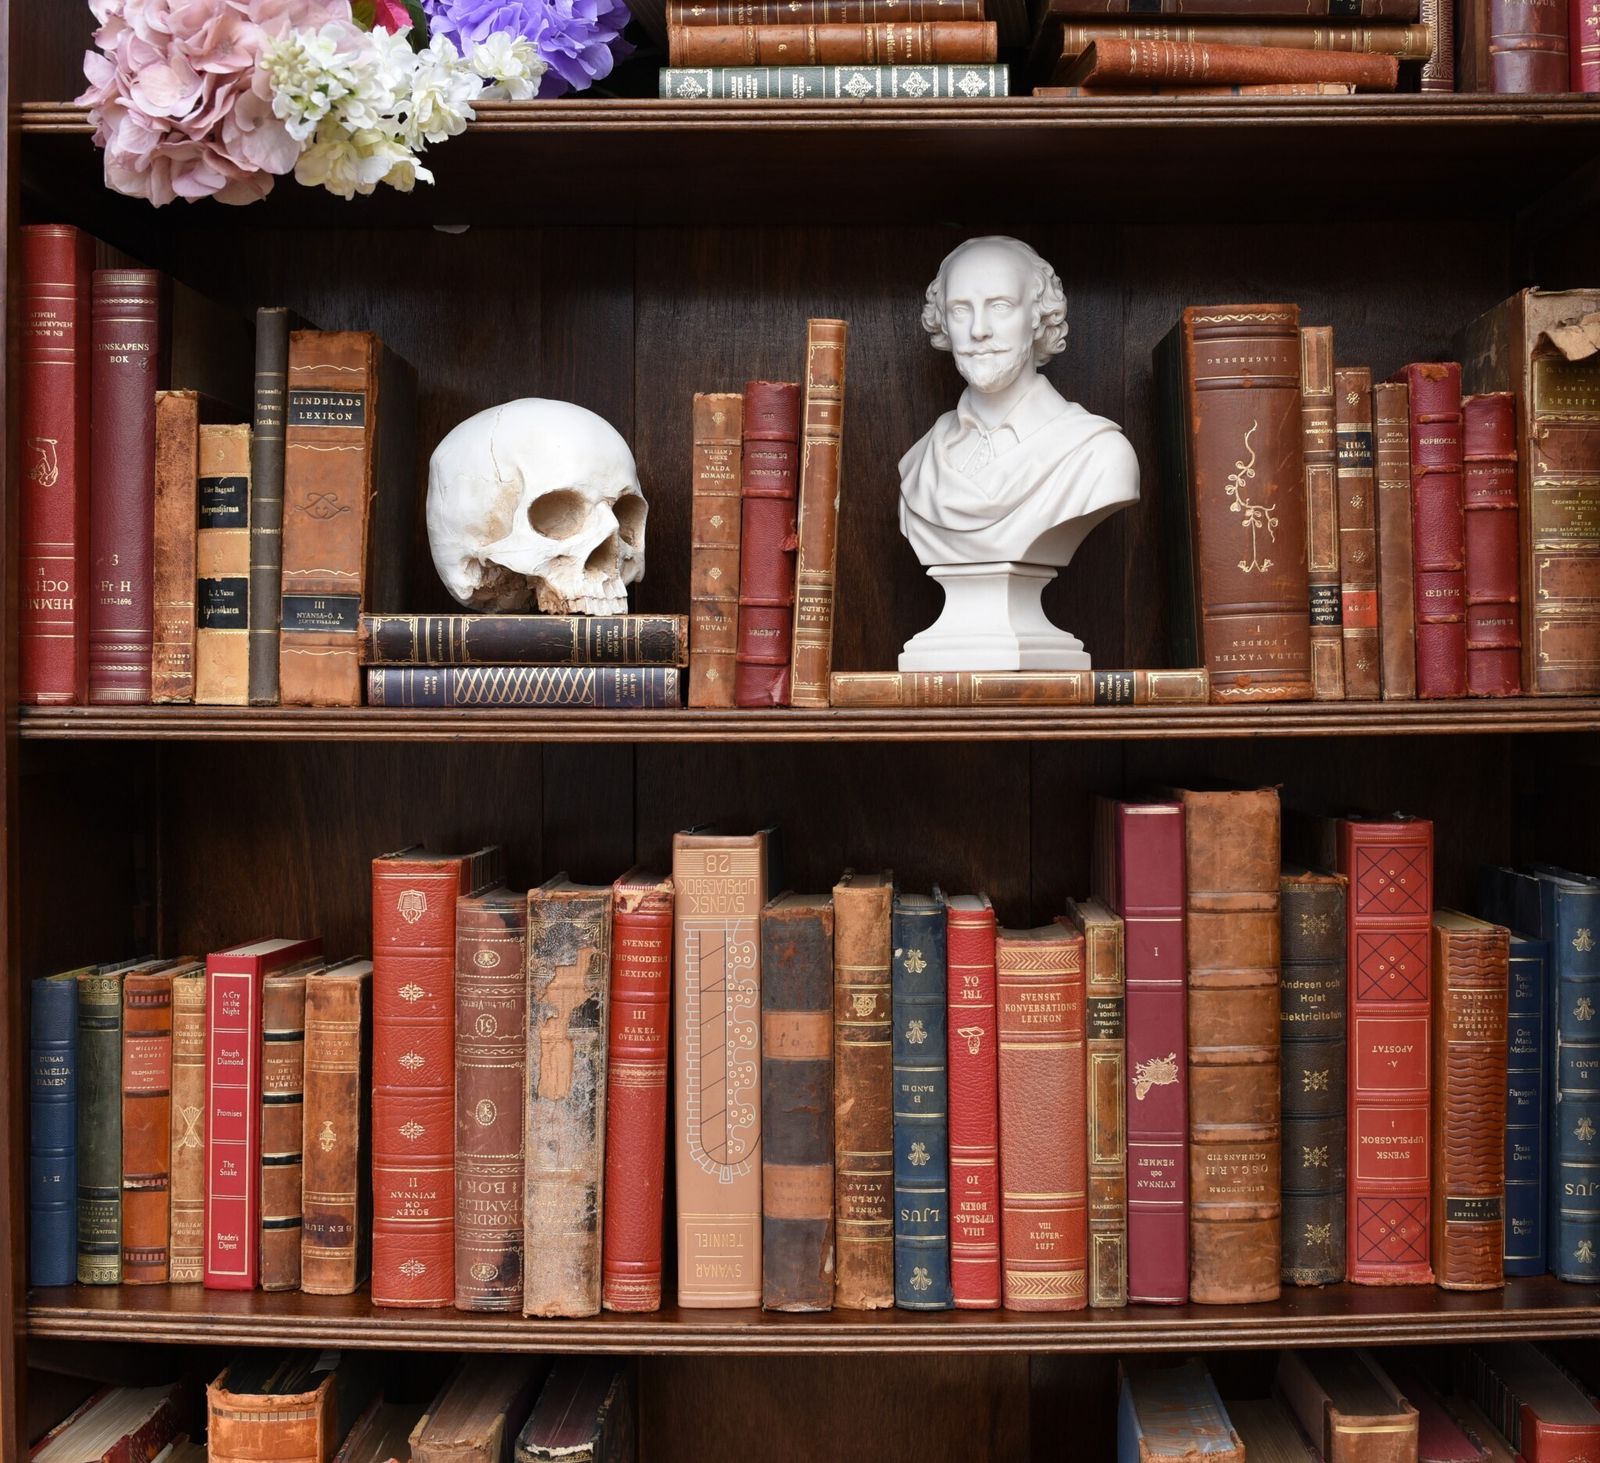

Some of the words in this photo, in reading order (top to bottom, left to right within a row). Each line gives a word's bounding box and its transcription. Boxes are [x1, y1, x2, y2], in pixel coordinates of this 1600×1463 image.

[98, 342, 150, 351] UNSKAPENS
[1207, 356, 1276, 364] LAGERBERG
[293, 397, 362, 406] LINDBLADS
[300, 412, 353, 420] LEXIKON
[112, 554, 119, 566] 3
[36, 580, 68, 592] OCH
[120, 580, 132, 592] H
[314, 600, 326, 610] III
[706, 855, 729, 873] 28
[679, 878, 756, 896] UPPSLAGSBOK
[689, 896, 745, 913] SVENSK
[622, 940, 662, 948] SVENSKT
[1154, 946, 1159, 957] I
[620, 970, 662, 978] LEXIKON
[963, 976, 979, 986] ÖÄ
[1326, 979, 1340, 988] och
[229, 992, 240, 1000] Cry
[960, 990, 982, 999] TRI-
[1020, 992, 1062, 1002] SVENSKT
[1300, 994, 1326, 1002] Holst
[222, 1008, 240, 1016] Night
[1005, 1002, 1077, 1013] KONVERSATIONS
[632, 1010, 646, 1020] III
[1022, 1014, 1062, 1024] LEXIKON
[480, 1018, 492, 1032] 31
[624, 1026, 656, 1034] KAKEL
[1517, 1028, 1531, 1036] One
[618, 1034, 661, 1042] ÖVERKAST
[221, 1049, 240, 1058] Rough
[1372, 1045, 1414, 1053] APOSTAT
[218, 1058, 244, 1066] Diamond
[1580, 1071, 1588, 1079] B
[914, 1095, 920, 1103] B
[217, 1109, 242, 1117] Promises
[1361, 1136, 1424, 1144] UPPSLAGSBOK
[1376, 1151, 1410, 1159] SVENSK
[1138, 1158, 1174, 1166] HEMMET
[1205, 1166, 1216, 1175] II
[1220, 1164, 1268, 1175] OSCAR
[408, 1178, 418, 1187] II
[967, 1175, 980, 1184] 10
[467, 1182, 506, 1194] BOK
[458, 1198, 518, 1212] FAMILJE
[960, 1202, 987, 1211] BOKEN
[458, 1212, 518, 1226] NORDISK
[901, 1208, 940, 1222] LJUS
[954, 1214, 994, 1224] UPPSLAGS-
[304, 1224, 324, 1232] HUR
[962, 1227, 985, 1236] LILLA
[218, 1232, 239, 1242] Reader's
[1030, 1231, 1064, 1240] KLÖVER-
[694, 1233, 744, 1248] TENNIEL
[218, 1242, 237, 1250] Digest
[696, 1264, 742, 1278] SVANAR
